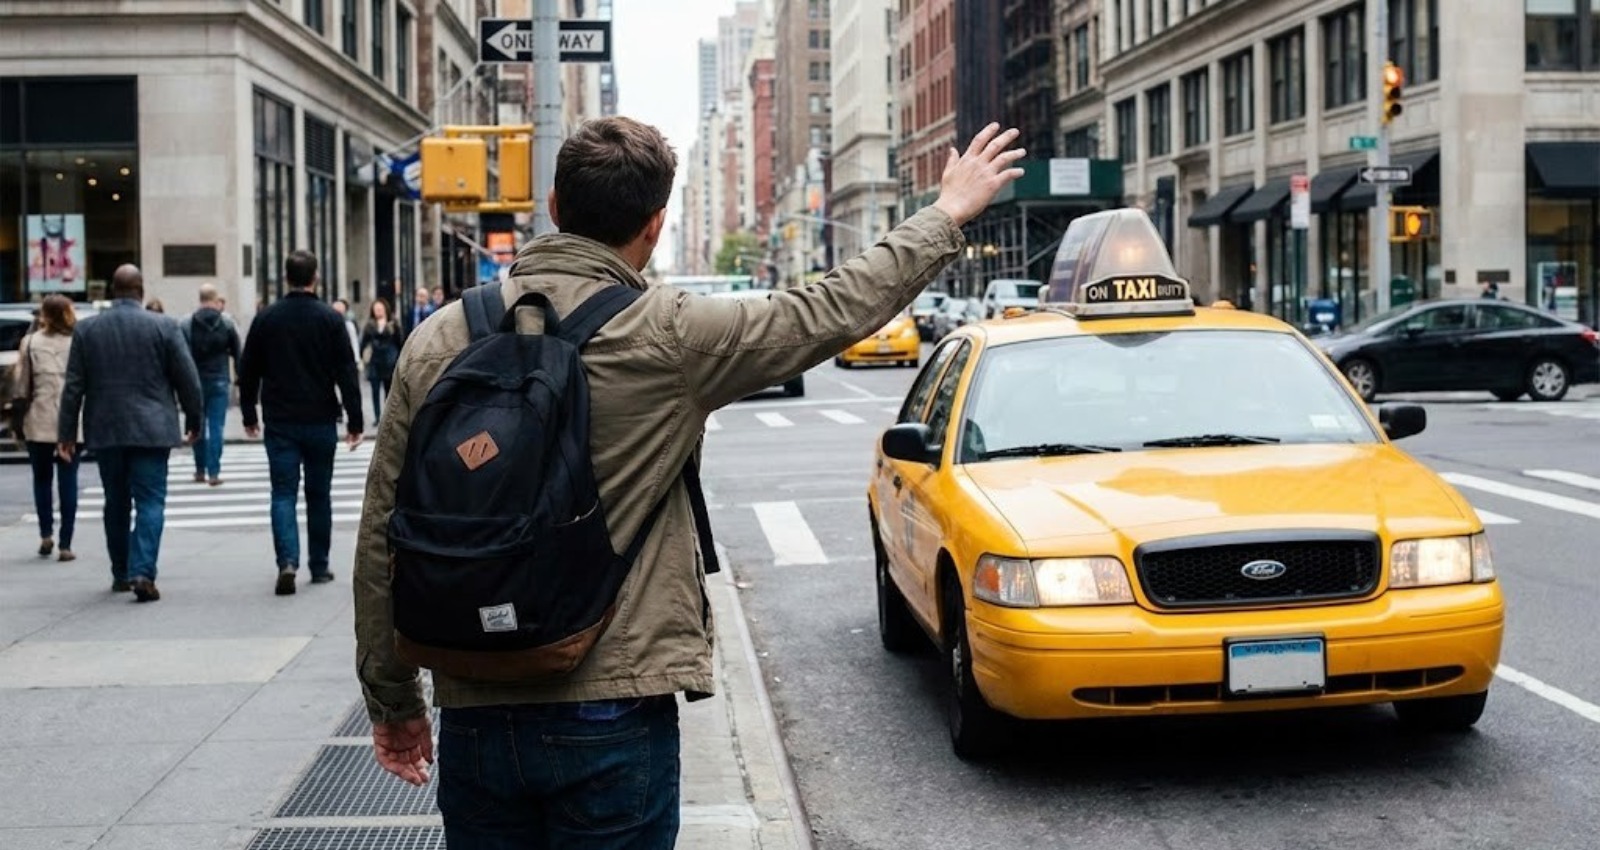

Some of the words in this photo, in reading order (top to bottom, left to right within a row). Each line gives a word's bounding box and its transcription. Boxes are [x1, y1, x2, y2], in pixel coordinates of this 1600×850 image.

[558, 34, 594, 49] WAY
[1088, 286, 1109, 300] ON
[1113, 278, 1156, 300] TAXI
